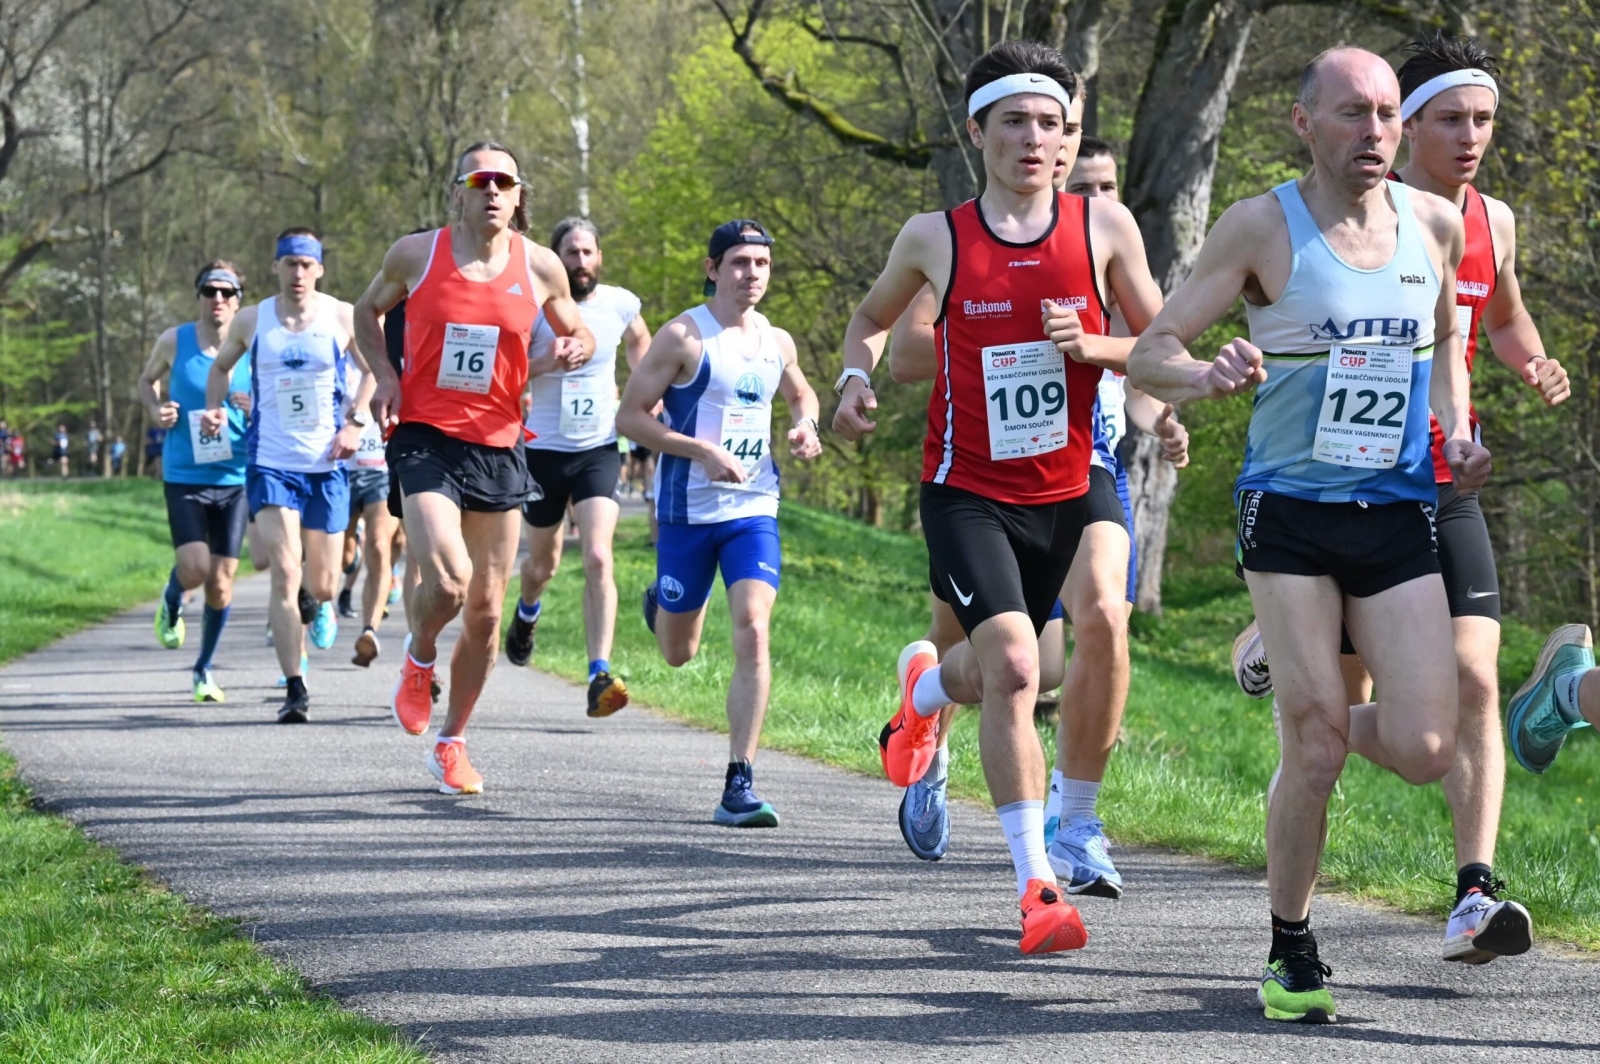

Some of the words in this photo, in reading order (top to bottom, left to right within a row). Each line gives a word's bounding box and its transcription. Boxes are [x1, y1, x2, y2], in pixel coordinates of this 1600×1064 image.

[1400, 274, 1426, 285] kalas
[1457, 280, 1489, 292] MARATON
[963, 300, 1012, 315] Krakonoš
[1312, 317, 1419, 340] ASTER
[453, 350, 485, 373] 16
[992, 357, 1017, 368] CUP
[1340, 356, 1367, 367] CUP
[1000, 371, 1038, 380] BABIČČINÝM
[1038, 367, 1063, 376] ÚDOLÍM
[1345, 374, 1383, 382] BABIČČINÝM
[1384, 376, 1409, 384] ÚDOLÍM
[292, 394, 304, 412] 5
[570, 398, 594, 416] 12
[989, 381, 1066, 421] 109
[1328, 388, 1406, 428] 122
[1004, 424, 1027, 432] ŠIMON
[1028, 420, 1054, 429] SOUČEK
[1320, 427, 1354, 435] FRANTISEK
[1354, 430, 1401, 439] VAGENKNECHT
[723, 438, 763, 460] 144
